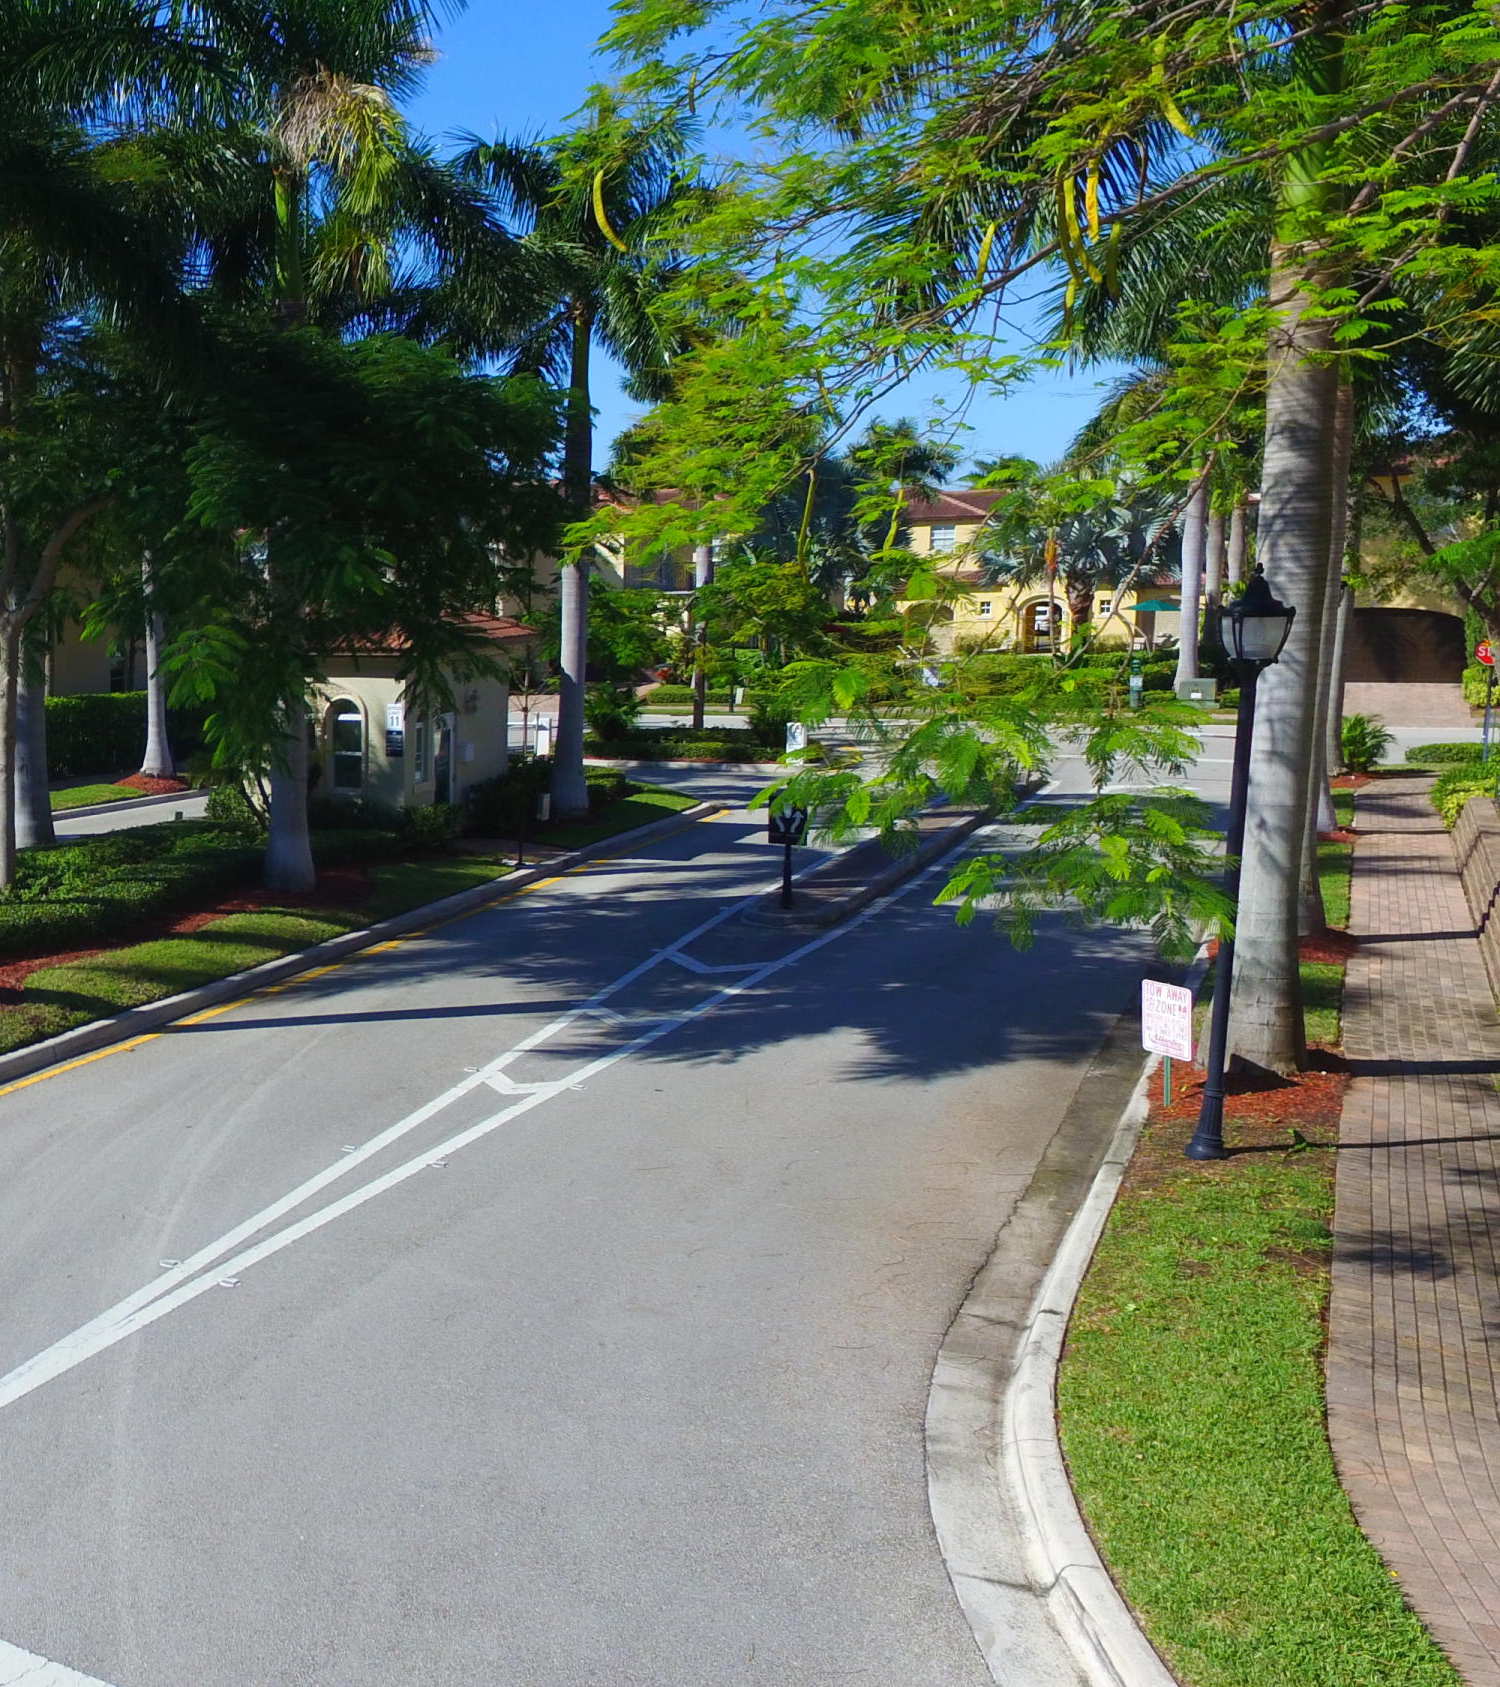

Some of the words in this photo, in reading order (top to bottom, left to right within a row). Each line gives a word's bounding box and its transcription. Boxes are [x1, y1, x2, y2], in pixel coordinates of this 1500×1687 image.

[1146, 983, 1162, 998] TOW
[1167, 989, 1187, 1004] AWAY
[1156, 1000, 1177, 1016] ZONE
